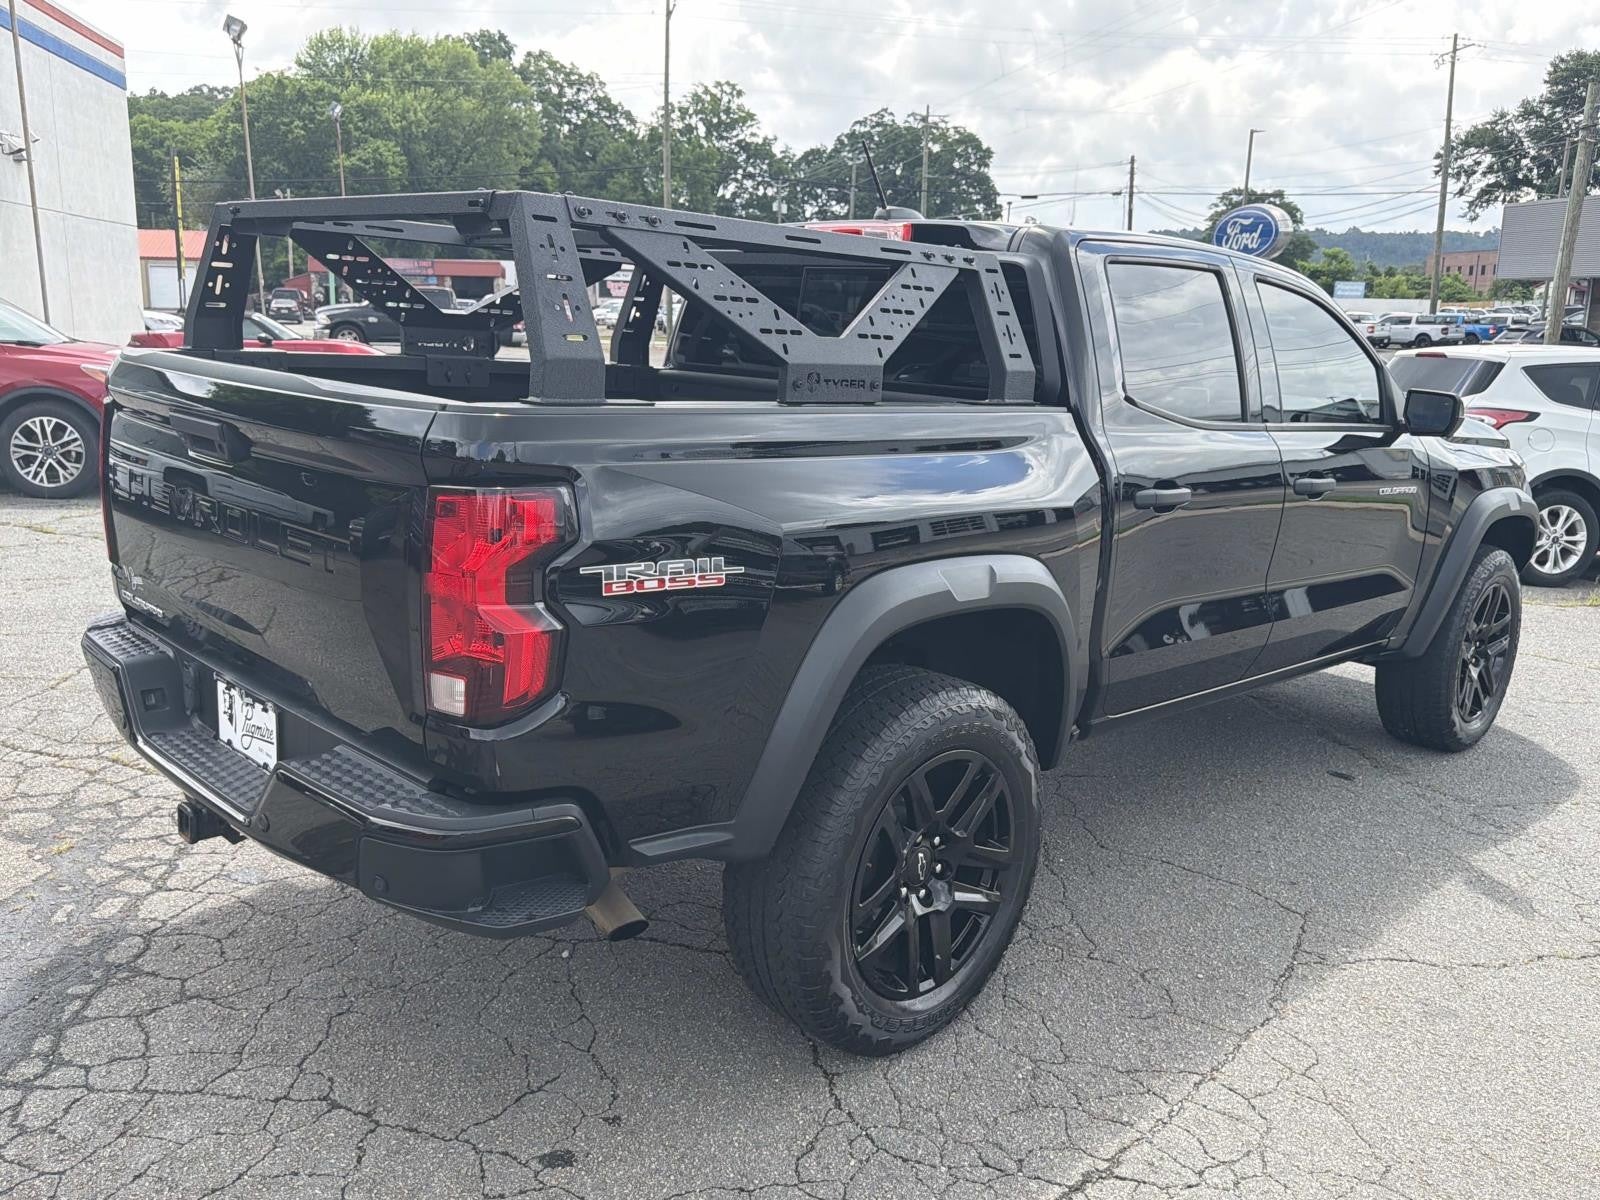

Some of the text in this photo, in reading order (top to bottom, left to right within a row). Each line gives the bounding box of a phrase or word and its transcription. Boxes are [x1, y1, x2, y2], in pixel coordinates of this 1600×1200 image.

[1222, 217, 1264, 250] Ford
[823, 378, 866, 390] TYGER
[109, 461, 351, 575] CHEVROLET
[579, 556, 745, 581] TRAIL
[602, 572, 726, 597] BOSS
[240, 702, 275, 751] Pugmire
